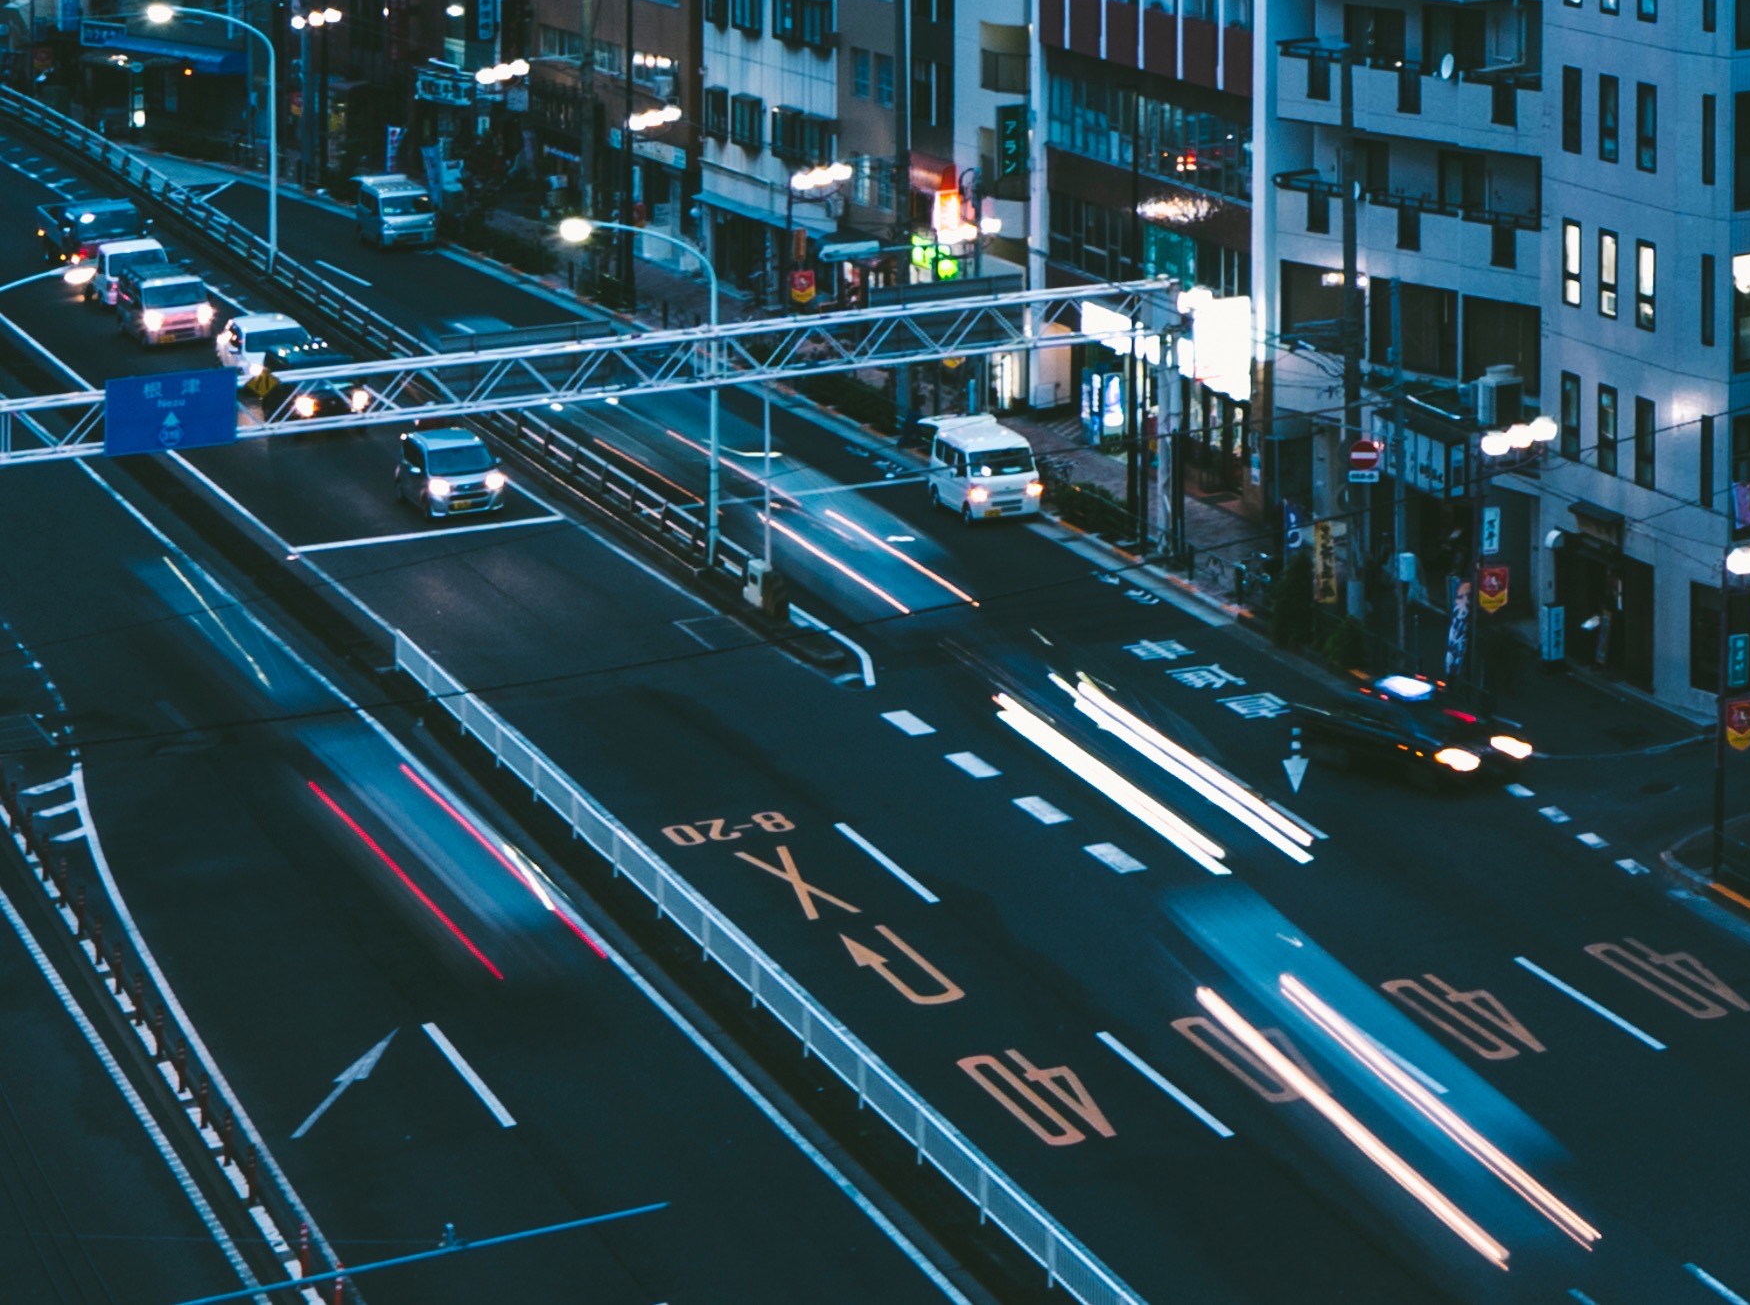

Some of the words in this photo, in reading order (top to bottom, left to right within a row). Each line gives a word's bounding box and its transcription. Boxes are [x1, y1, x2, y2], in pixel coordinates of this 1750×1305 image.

[1004, 120, 1017, 174] アラン
[661, 811, 796, 847] 8-20
[1380, 974, 1547, 1061] 40
[956, 1049, 1117, 1147] 40
